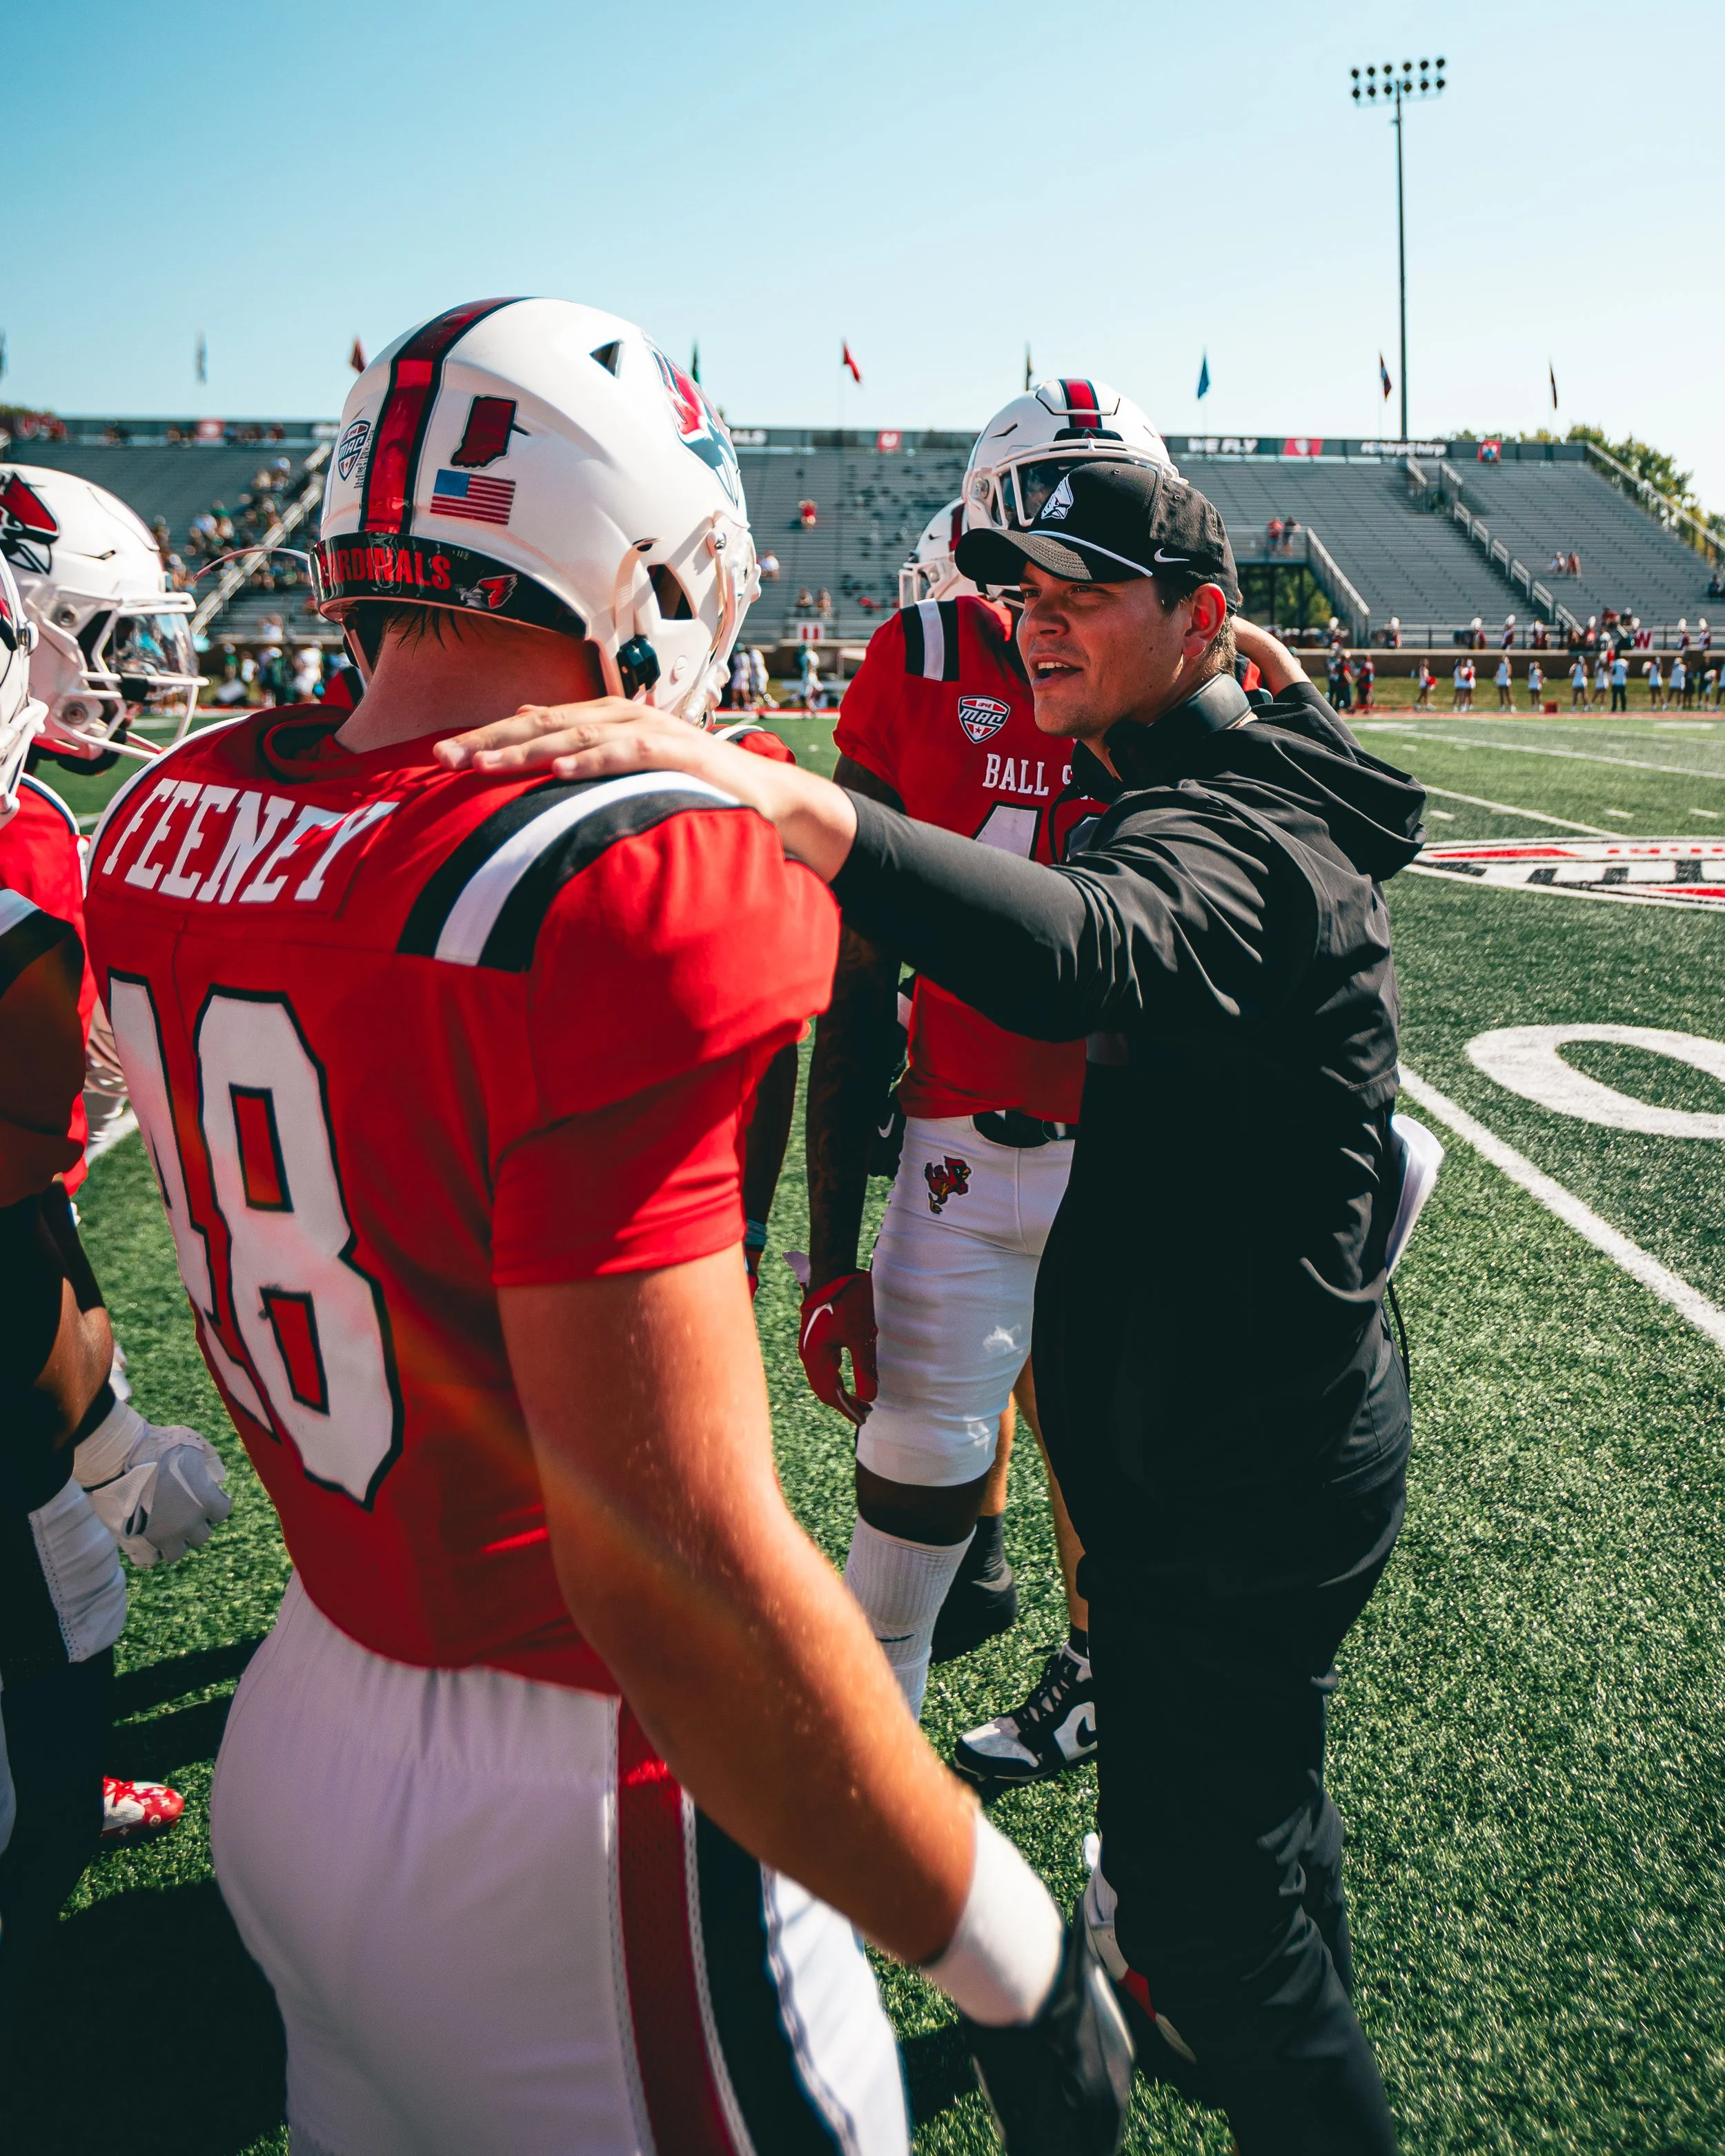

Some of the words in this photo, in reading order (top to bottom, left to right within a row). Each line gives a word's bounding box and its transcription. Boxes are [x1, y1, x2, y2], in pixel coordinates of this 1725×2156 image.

[340, 435, 365, 459] MAC
[960, 708, 1003, 726] MAC
[983, 753, 1049, 795] BALL
[101, 778, 400, 904] FEENEY
